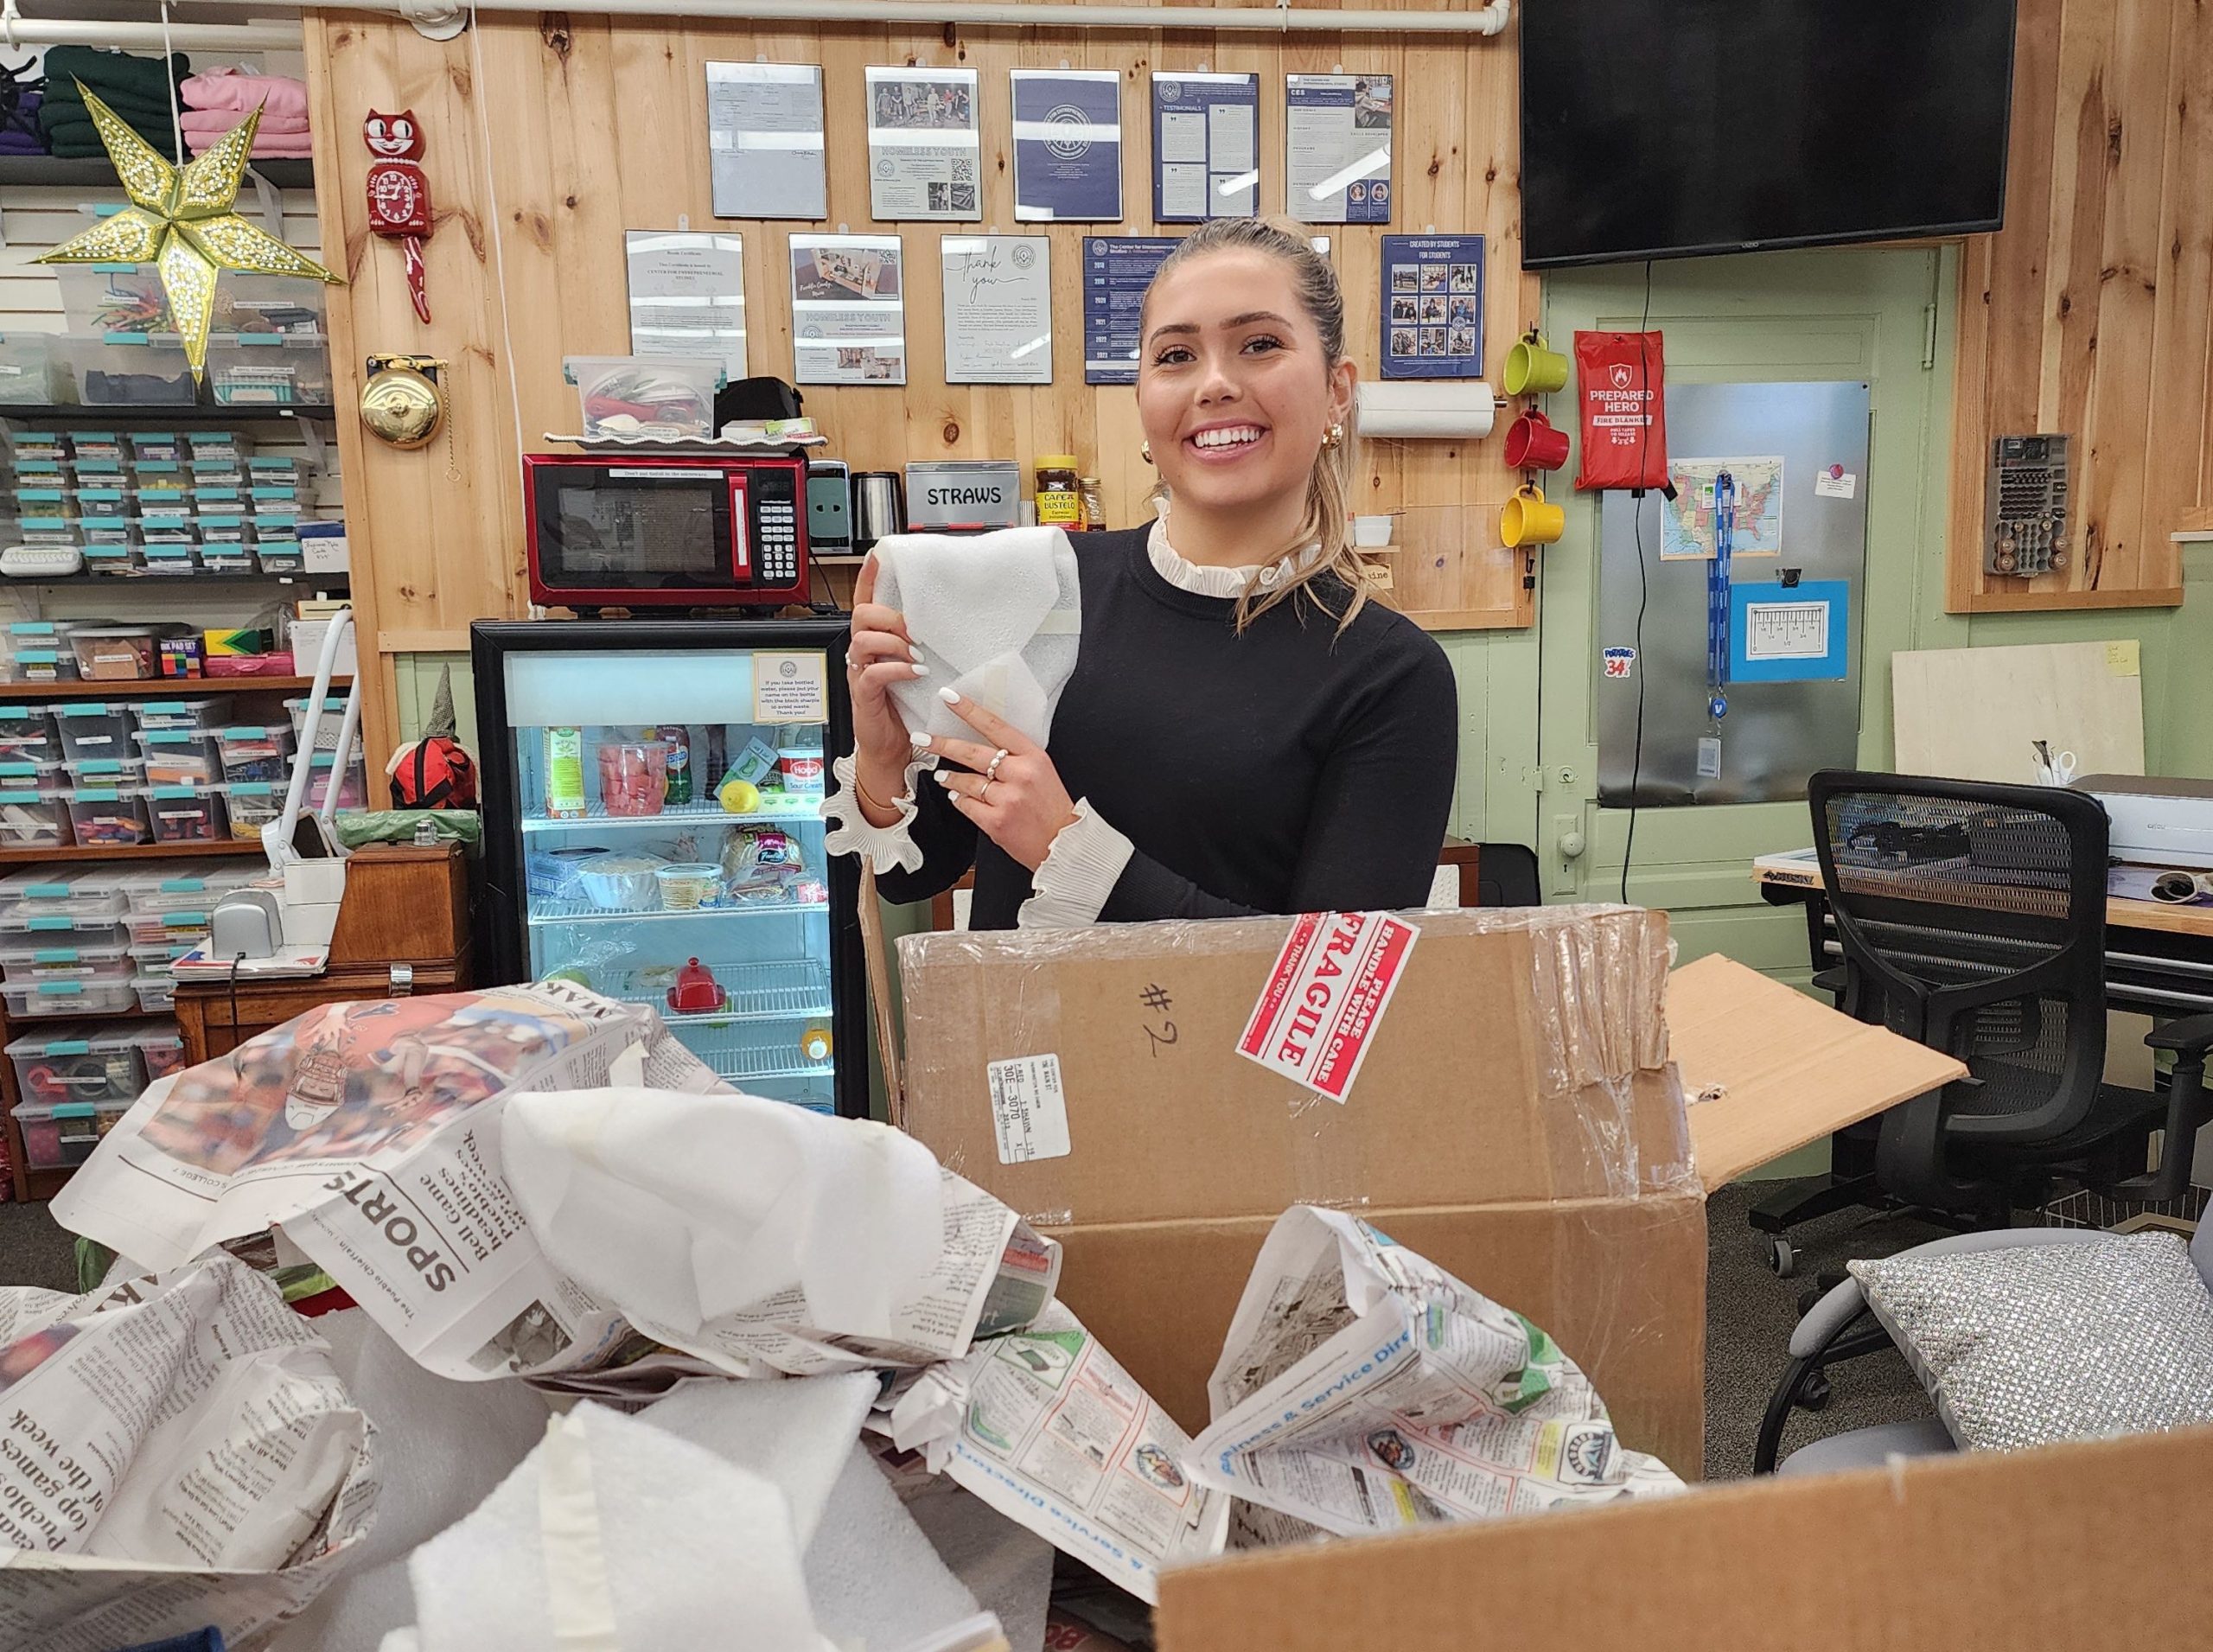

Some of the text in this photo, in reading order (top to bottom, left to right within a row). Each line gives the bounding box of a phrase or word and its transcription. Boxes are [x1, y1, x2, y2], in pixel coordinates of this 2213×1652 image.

[934, 147, 966, 156] YOUTH
[946, 246, 1001, 282] Thank
[970, 277, 1029, 304] you
[806, 312, 890, 322] HOMELESS YOUTH
[1590, 390, 1654, 401] PREPARED
[1604, 402, 1639, 412] HERO
[928, 488, 1002, 505] STRAWS
[160, 642, 170, 651] INK
[184, 641, 196, 650] SET
[1604, 648, 1635, 658] POTATOES
[794, 765, 818, 774] Hood
[1776, 872, 1814, 885] HUSKY
[1276, 945, 1304, 998] THANK YOU
[1278, 913, 1366, 1067] FRAGILE
[1317, 925, 1394, 1082] HANDLE WITH CARE
[1350, 978, 1384, 1039] PLEASE
[463, 1129, 488, 1177] week
[179, 1170, 221, 1188] COLLEGE
[419, 1174, 489, 1262] Bell Game
[438, 1167, 503, 1253] headlines
[460, 1170, 513, 1241] Pueblo's
[322, 1170, 456, 1292] SPORTS
[339, 1241, 374, 1277] Chieftain
[374, 1274, 400, 1304] Pueblo
[1300, 1361, 1373, 1414] Service
[0, 1438, 66, 1499] games
[9, 1408, 104, 1514] of the week
[955, 1442, 1046, 1508] Directory
[57, 1497, 88, 1533] top
[1049, 1507, 1126, 1560] Service
